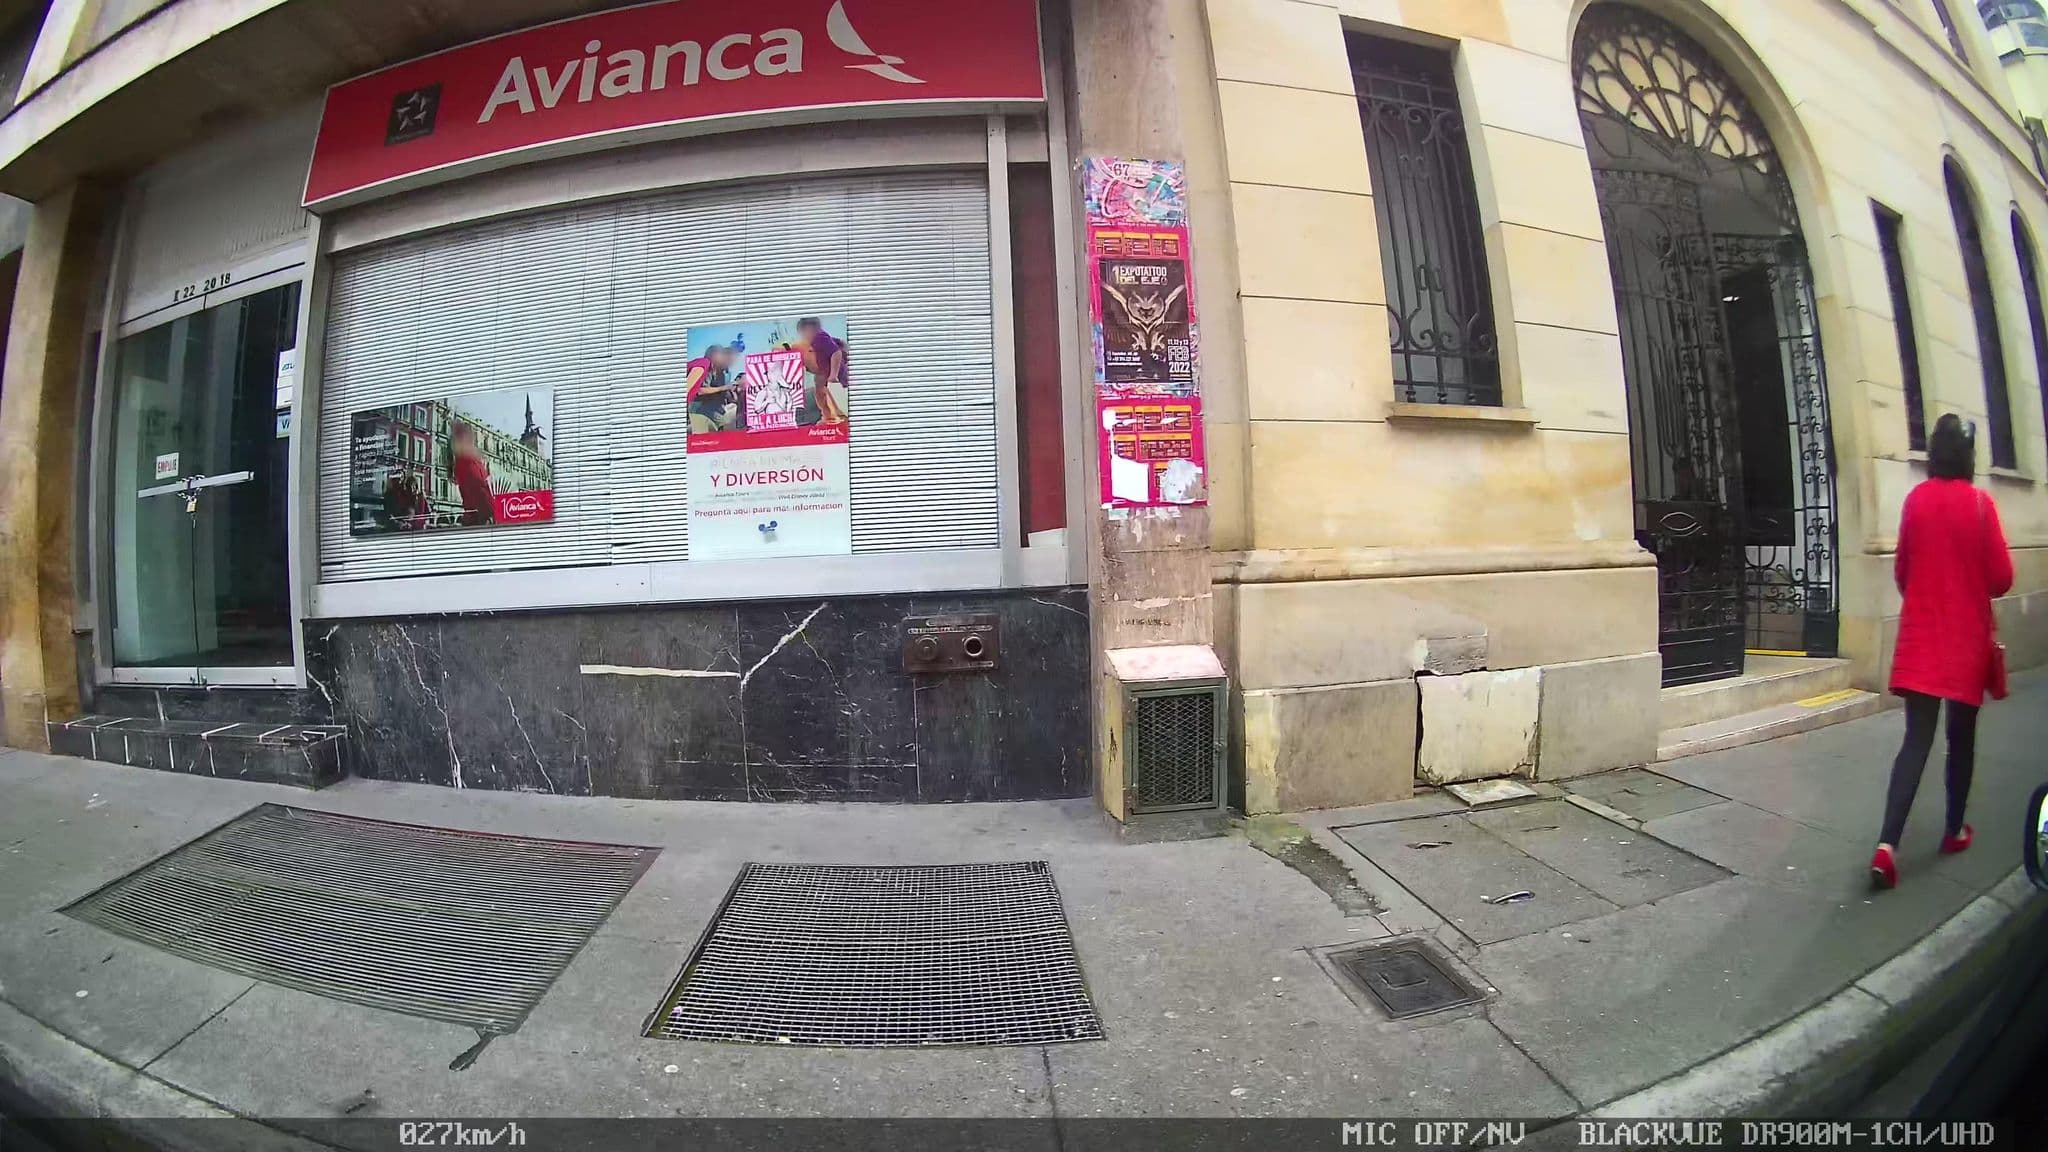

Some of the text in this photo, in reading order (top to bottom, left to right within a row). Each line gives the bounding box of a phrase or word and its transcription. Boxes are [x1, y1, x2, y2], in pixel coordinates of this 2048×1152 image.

[477, 28, 803, 123] Avianca
[1119, 265, 1167, 277] EXPOTATTOO
[1168, 346, 1190, 361] FEB
[1169, 361, 1191, 373] 2022
[808, 427, 836, 437] Avianca
[710, 466, 824, 488] Y DIVERSIÓN
[694, 509, 731, 518] Pregunta
[752, 506, 771, 515] para
